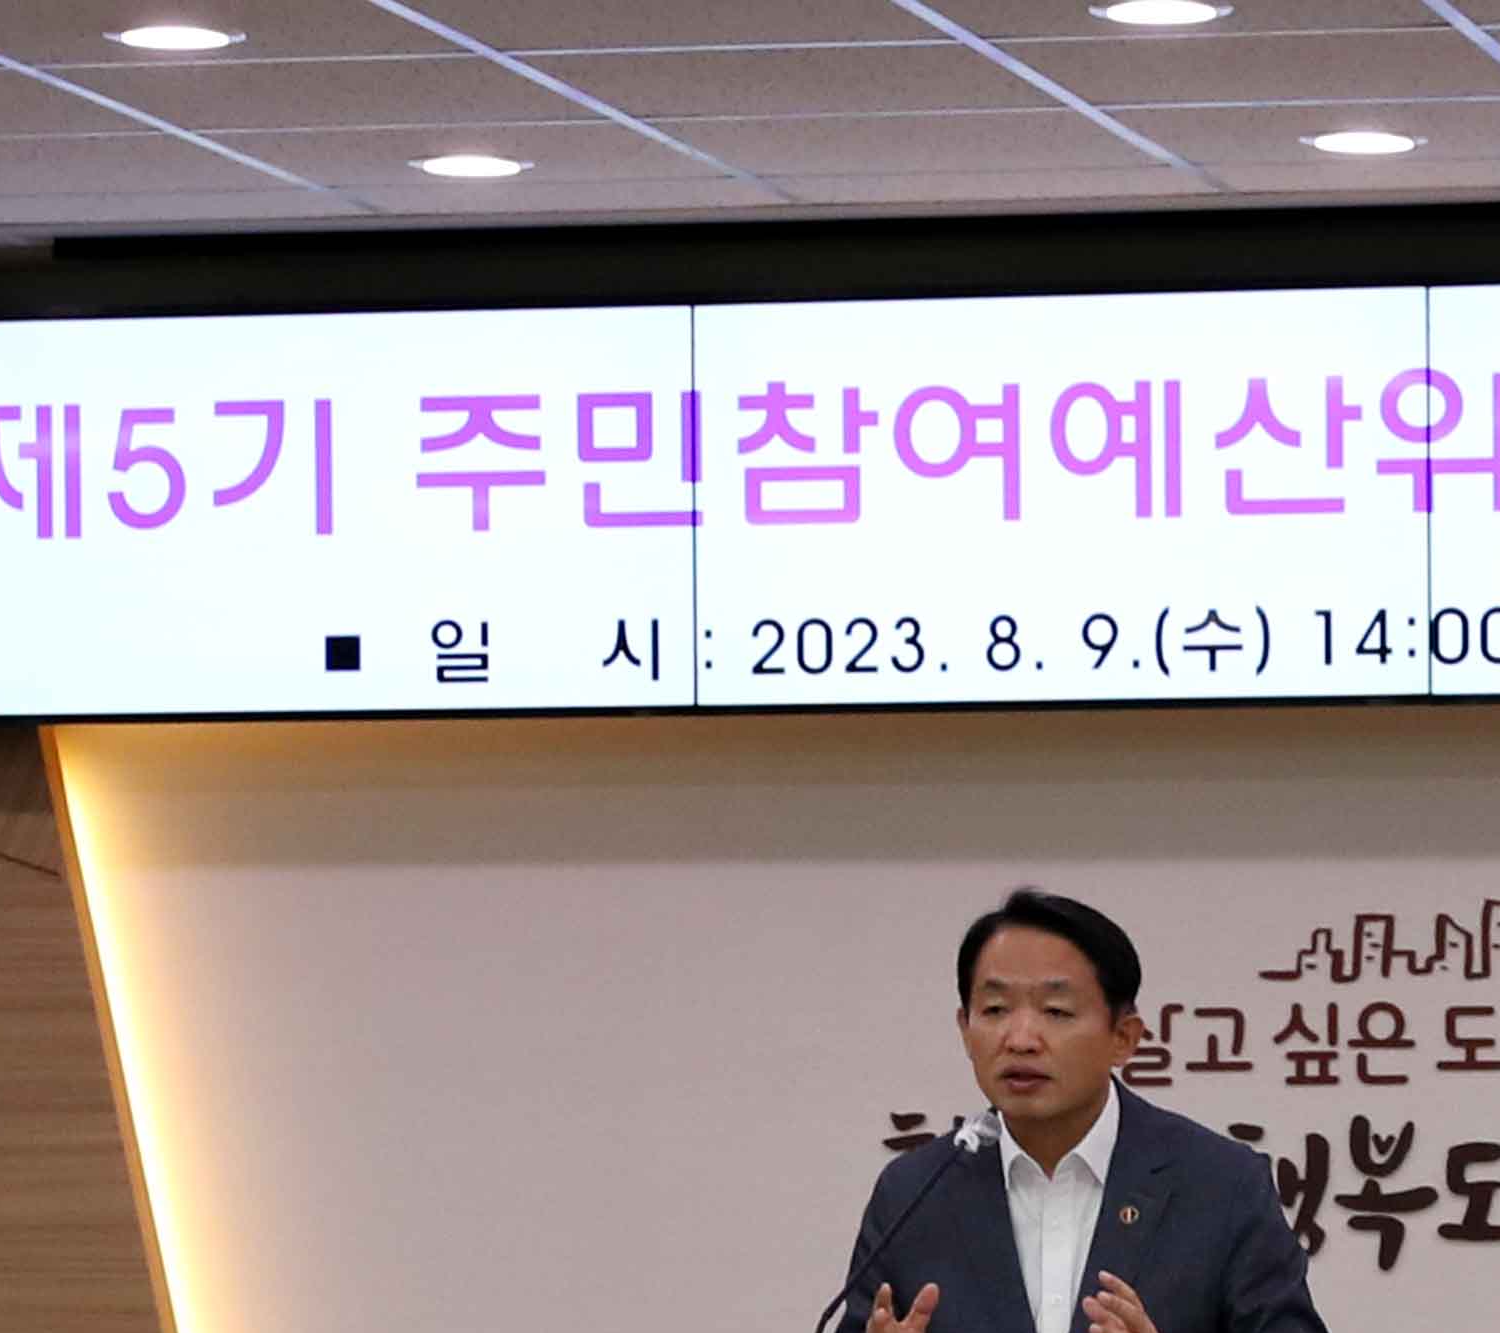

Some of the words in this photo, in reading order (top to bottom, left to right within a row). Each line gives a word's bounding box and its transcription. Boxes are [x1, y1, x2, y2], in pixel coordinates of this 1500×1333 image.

[751, 616, 948, 675] 2023.
[1116, 1002, 1255, 1088] 살고
[1272, 1001, 1417, 1087] 싶은
